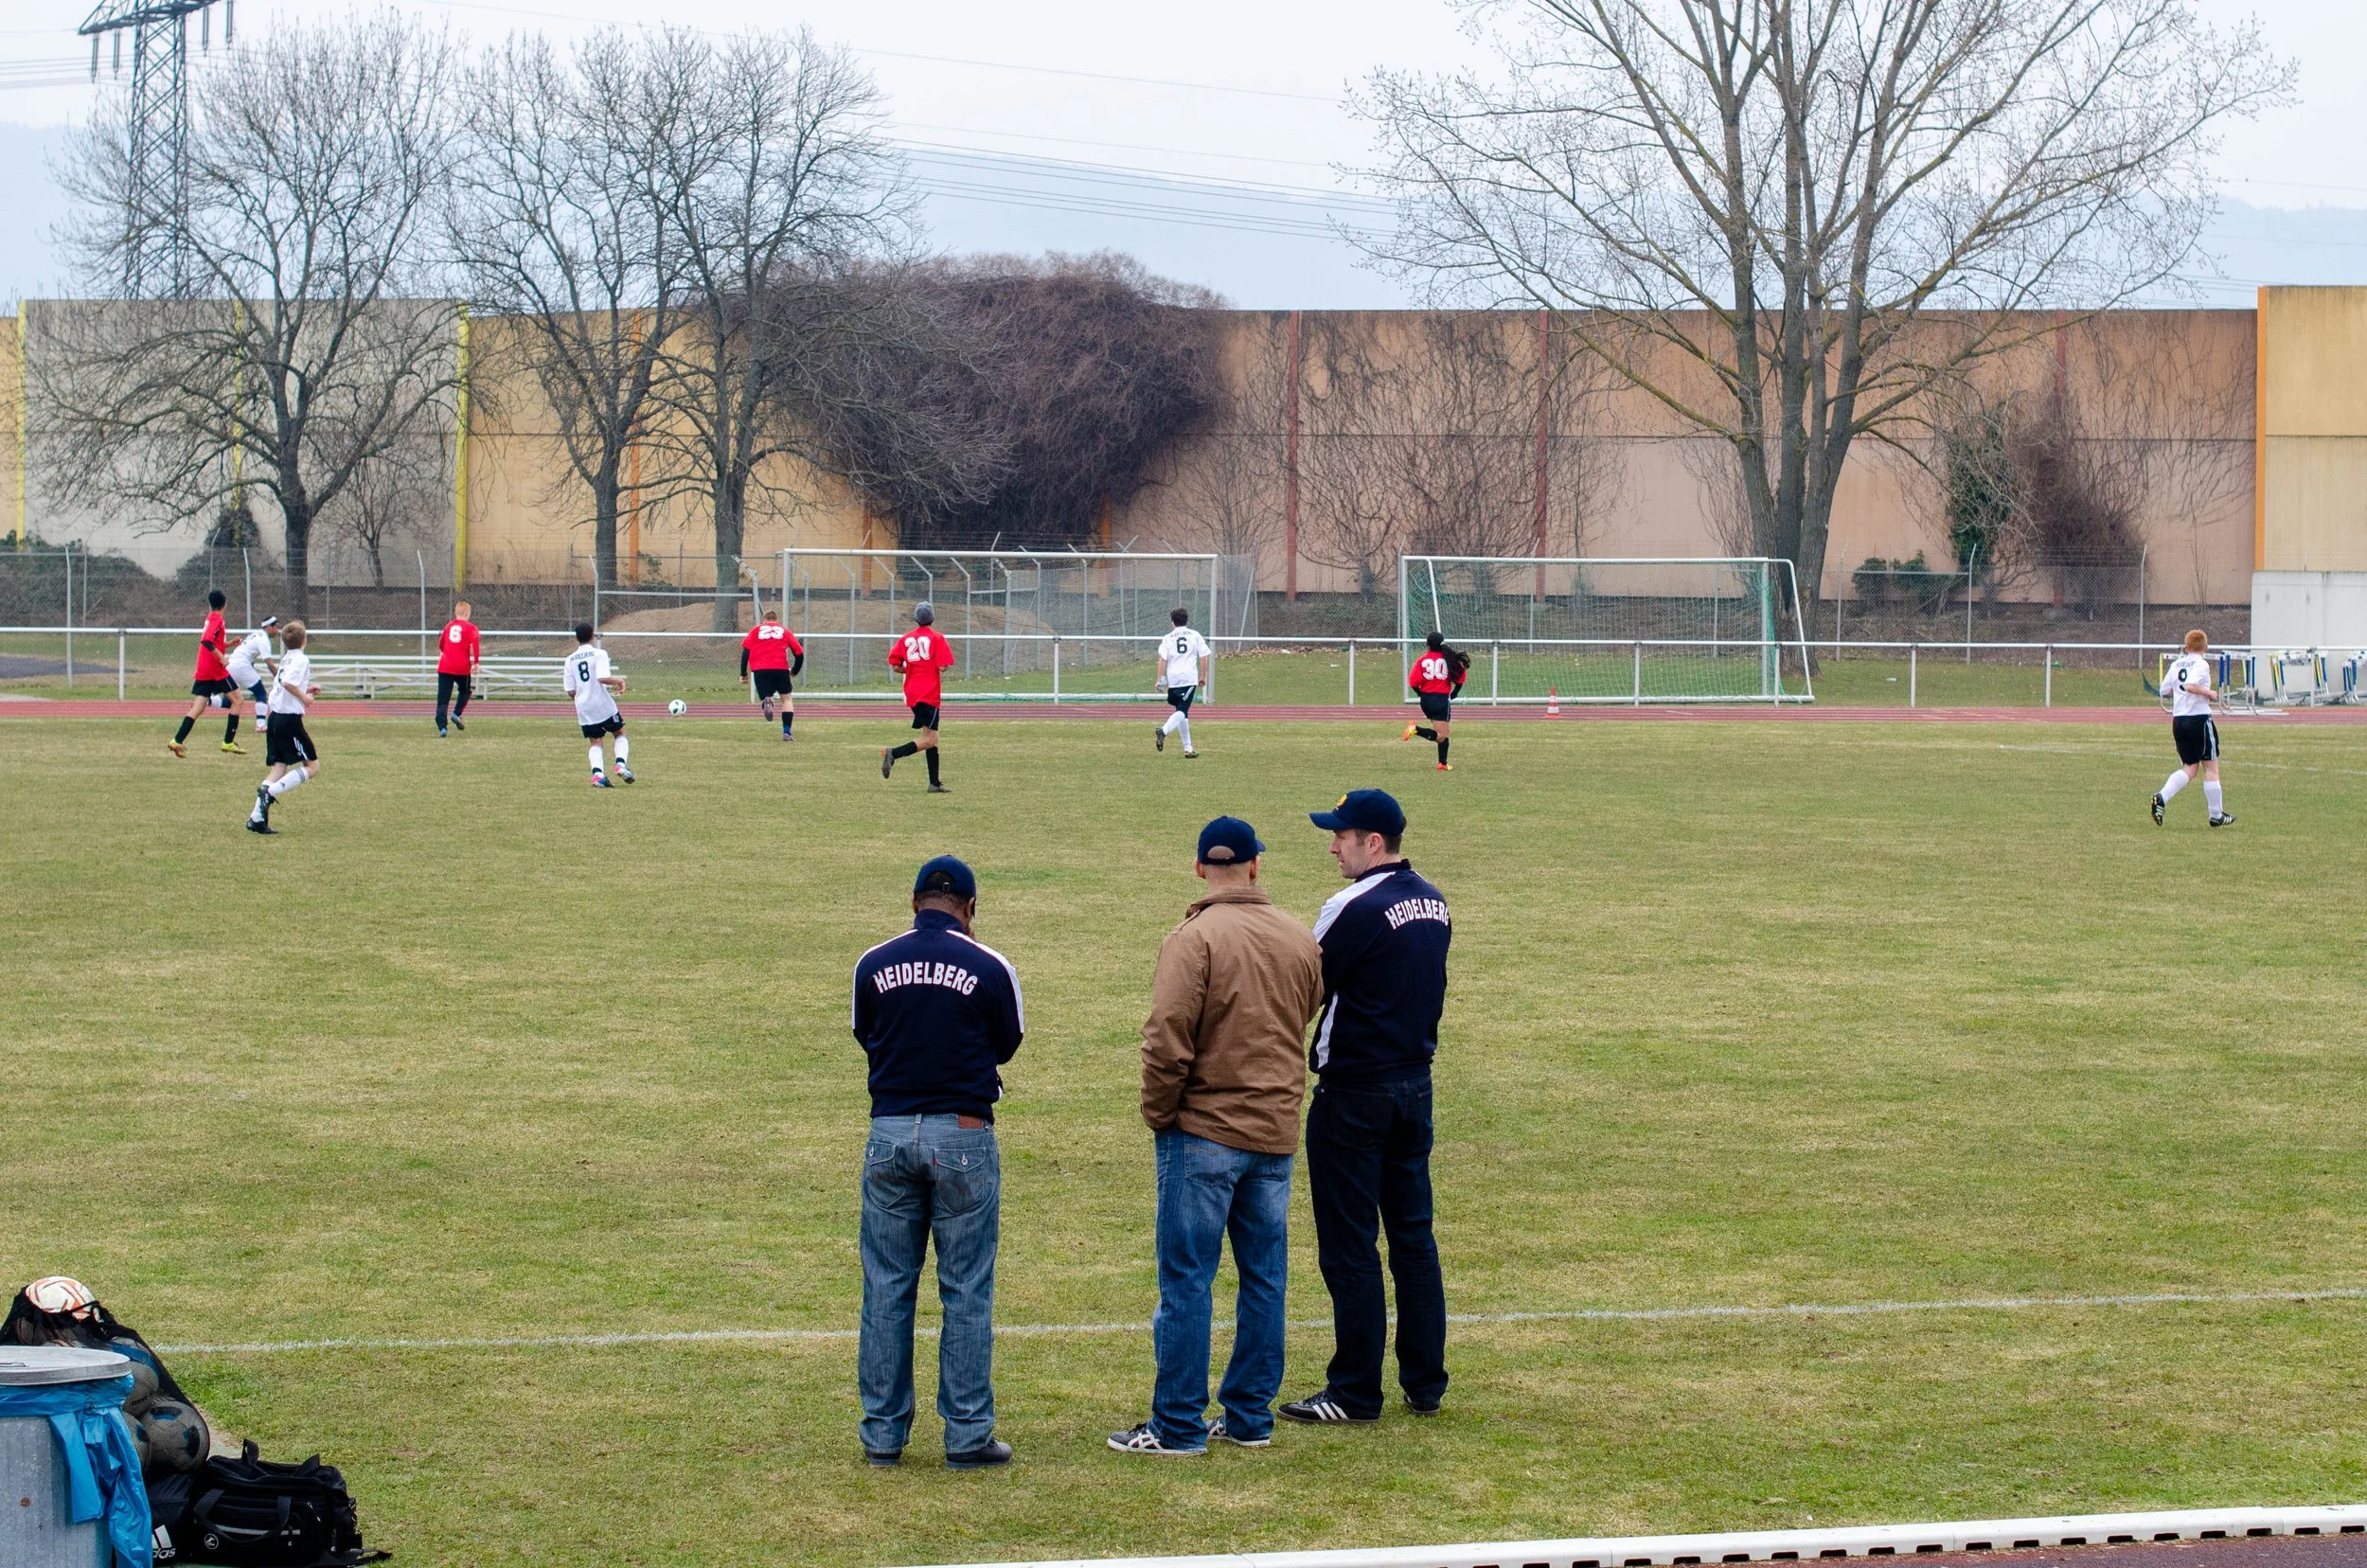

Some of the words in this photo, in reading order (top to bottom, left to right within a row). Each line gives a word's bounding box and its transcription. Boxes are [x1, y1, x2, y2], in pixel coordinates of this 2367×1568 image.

[758, 625, 784, 639] 23
[904, 636, 931, 662] 20
[1177, 637, 1187, 654] 6
[578, 661, 590, 682] 8
[1421, 658, 1448, 680] 30
[2179, 668, 2187, 691] 9
[872, 962, 978, 995] HEIDELBERG
